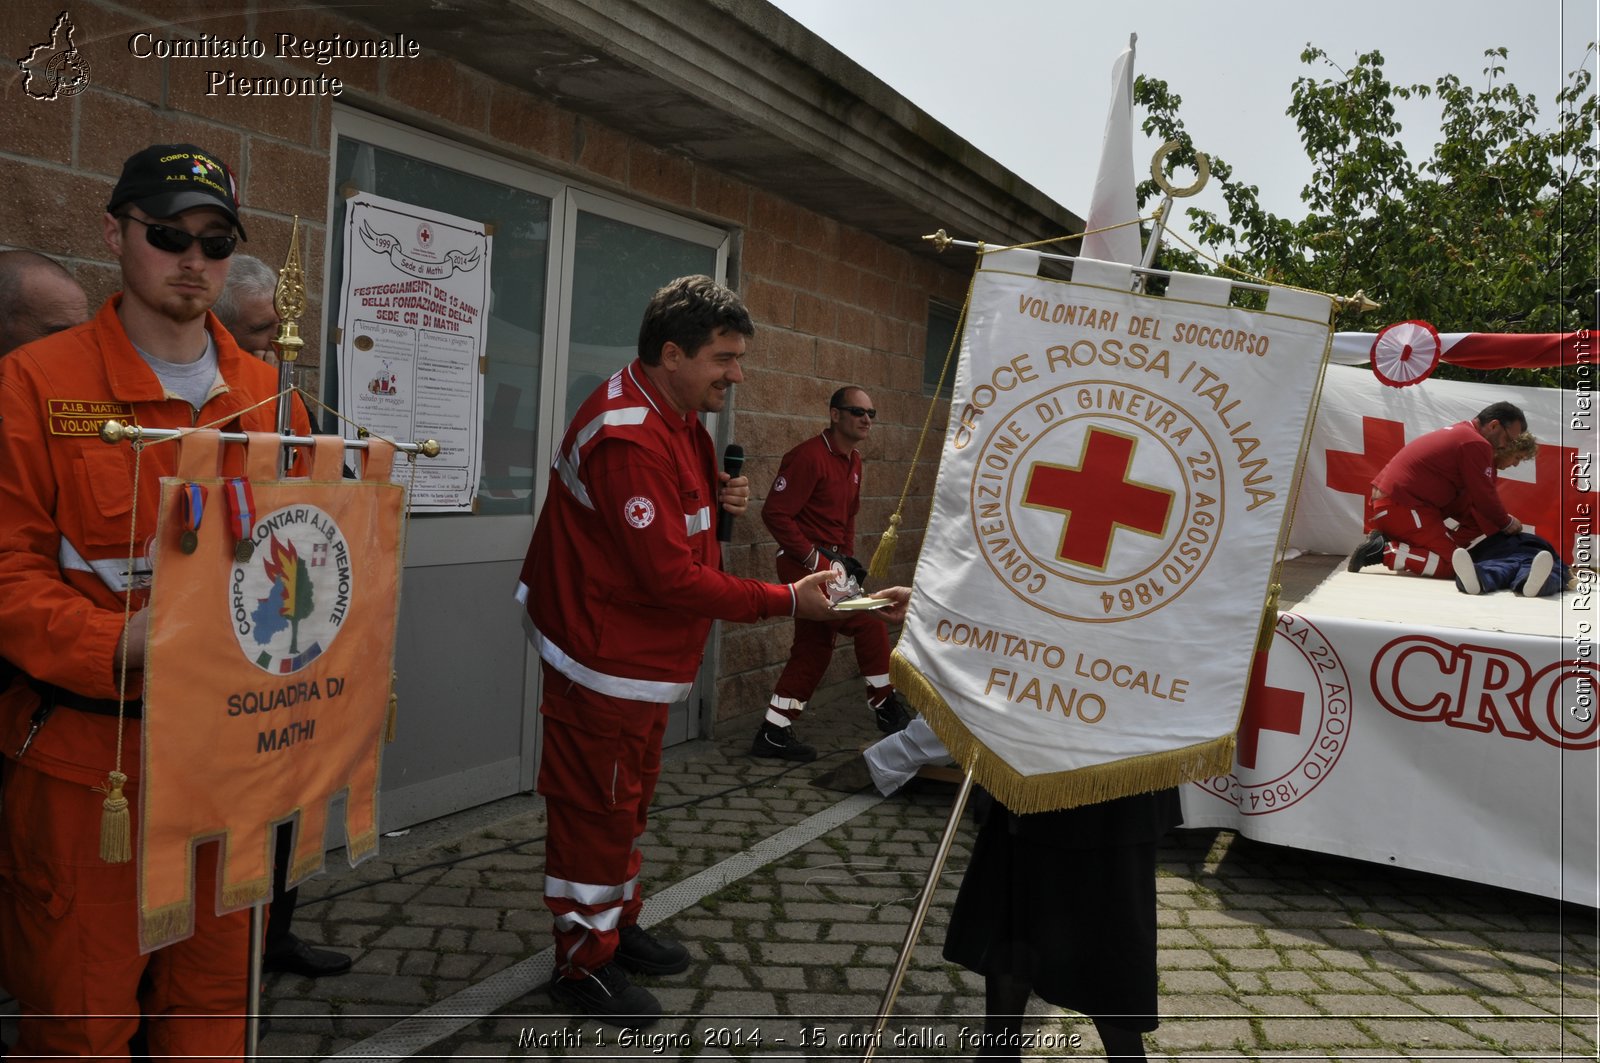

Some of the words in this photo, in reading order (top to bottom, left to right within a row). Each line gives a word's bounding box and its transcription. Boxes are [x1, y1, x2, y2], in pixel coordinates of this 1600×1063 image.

[160, 153, 189, 163] CORPO
[375, 237, 391, 249] 1999
[454, 255, 467, 266] 2014
[401, 258, 416, 272] Sede
[418, 264, 424, 274] di
[426, 266, 443, 276] Mathi
[354, 280, 432, 297] FESTEGGIAMENTI
[434, 286, 447, 302] DEI
[449, 295, 458, 308] 15
[362, 297, 390, 307] DELLA
[393, 296, 447, 317] FONDAZIONE
[448, 307, 473, 325] DELLA
[376, 309, 399, 322] SEDE
[404, 311, 418, 325] CRI
[423, 314, 431, 328] DI
[1019, 294, 1119, 332] VOLONTARI
[1128, 316, 1162, 340] DEL
[1172, 323, 1269, 357] SOCCORSO
[62, 403, 86, 412] A.I.B.
[91, 405, 123, 413] MATHI
[953, 353, 1039, 451] CROCE
[1046, 339, 1170, 379] ROSSA
[1178, 361, 1276, 512] ITALIANA
[1036, 397, 1065, 424] DI
[1076, 388, 1194, 446] GINEVRA
[1187, 451, 1217, 483] 22
[978, 421, 1047, 594] CONVENZIONE
[1163, 491, 1217, 585] AGOSTO
[233, 568, 251, 636] CORPO
[311, 512, 334, 545] A.I.B.
[329, 541, 349, 627] PIEMONTE
[1099, 577, 1165, 614] 1864
[935, 619, 1065, 669] COMITATO
[1075, 653, 1190, 703] LOCALE
[1309, 646, 1336, 673] 22
[227, 681, 320, 717] SQUADRA
[326, 677, 345, 696] DI
[984, 667, 1107, 724] FIANO
[1370, 635, 1600, 750] CRO
[257, 719, 315, 754] MATHI
[1304, 682, 1347, 781] AGOSTO
[1250, 780, 1299, 810] 1864
